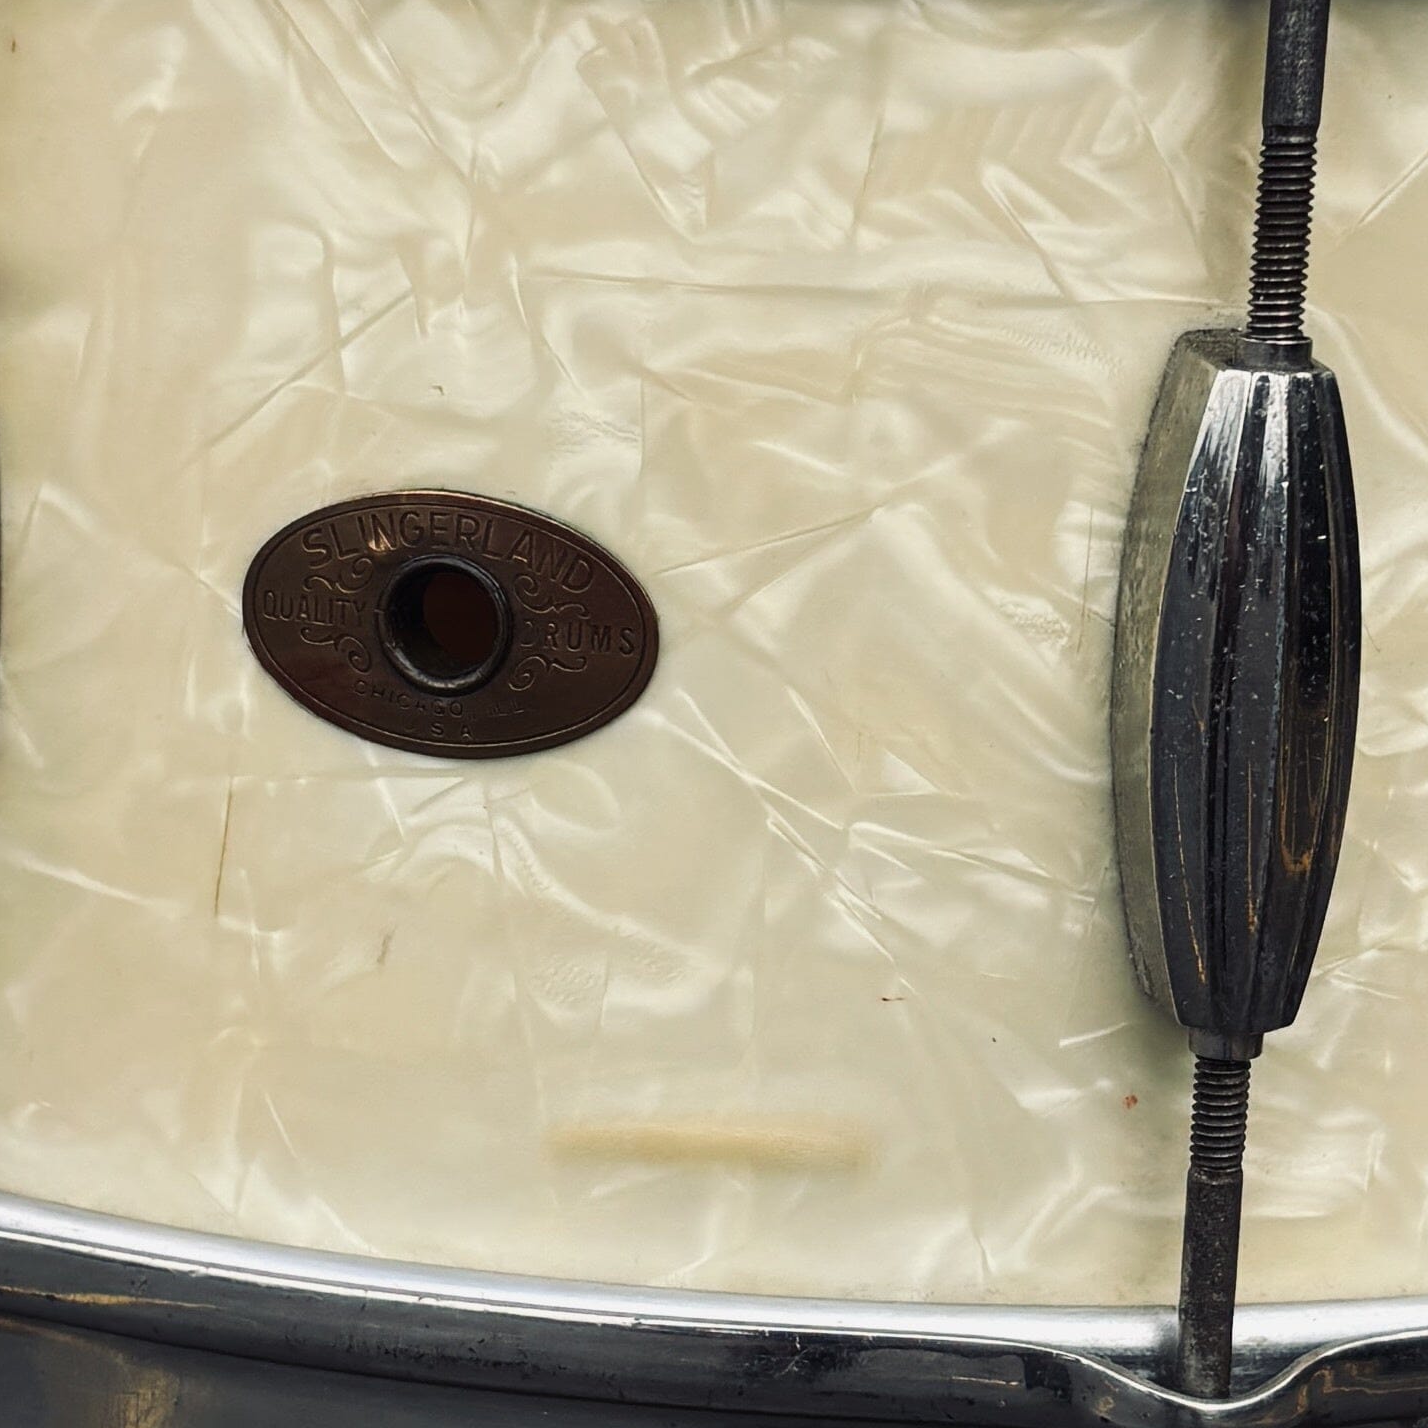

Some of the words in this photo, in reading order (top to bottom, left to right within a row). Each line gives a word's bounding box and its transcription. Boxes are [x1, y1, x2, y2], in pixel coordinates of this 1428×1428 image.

[302, 511, 594, 593] SLINGERLAND
[263, 590, 367, 627] QUALITY
[521, 620, 635, 657] DRUMS
